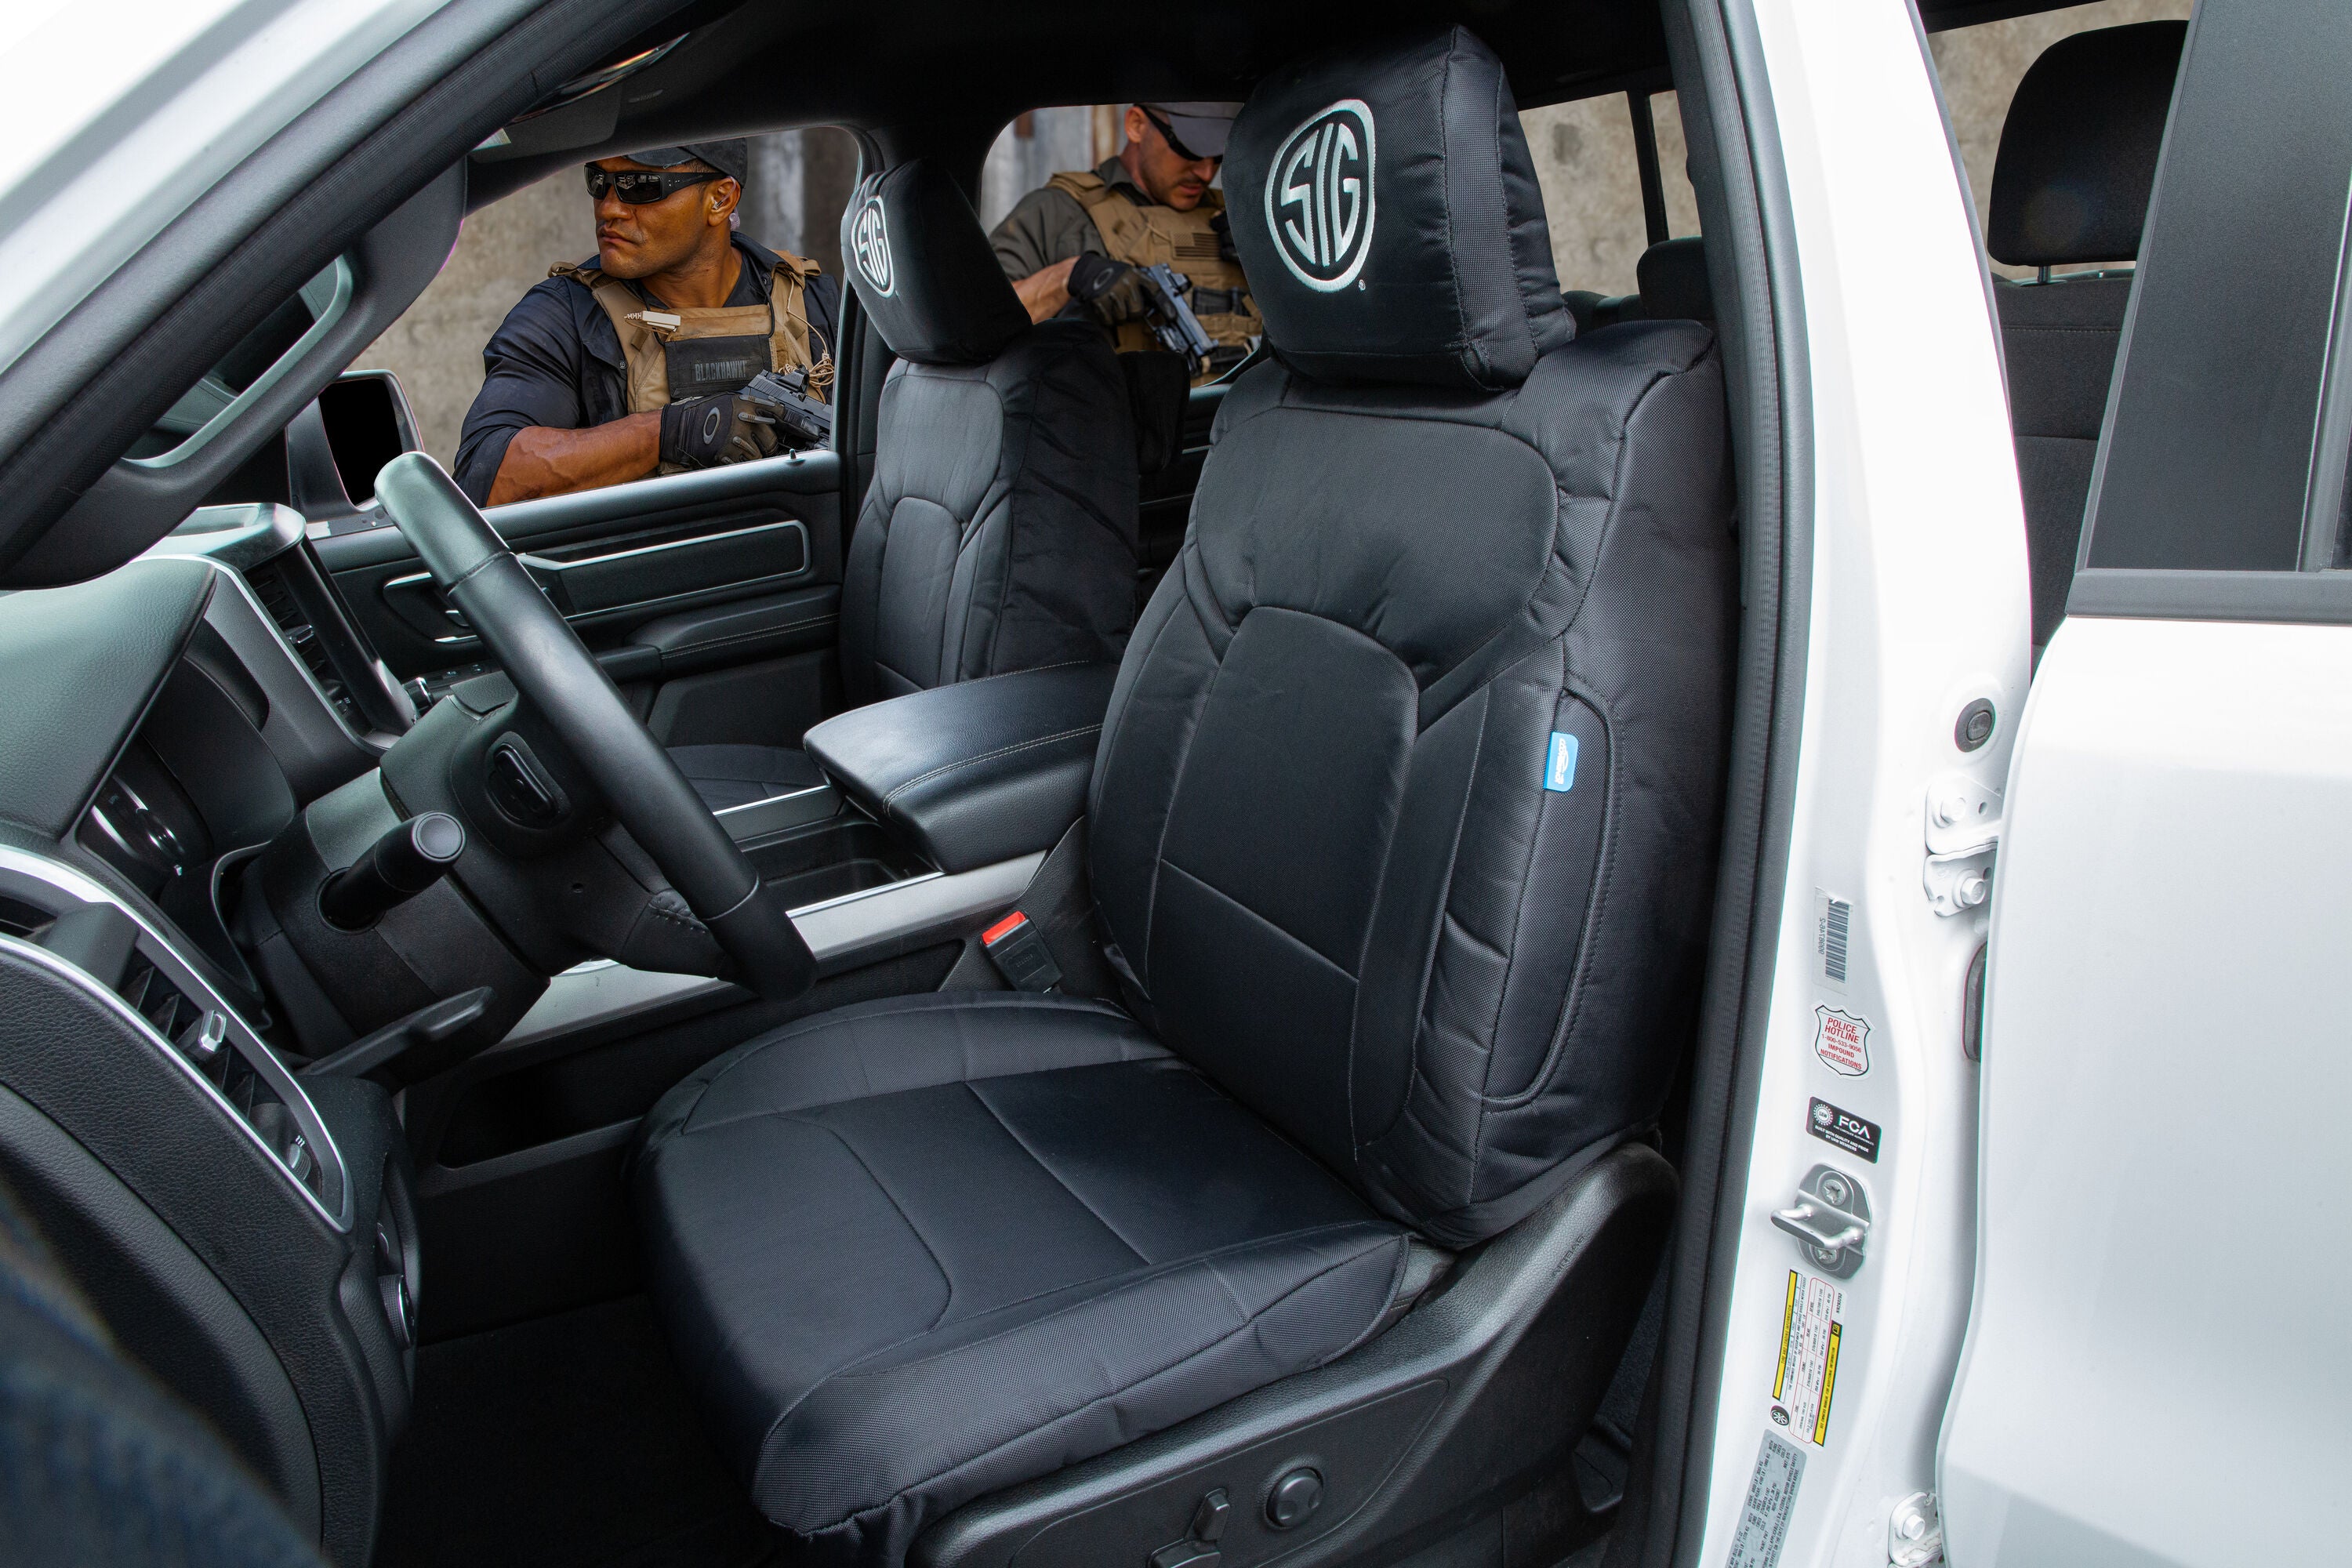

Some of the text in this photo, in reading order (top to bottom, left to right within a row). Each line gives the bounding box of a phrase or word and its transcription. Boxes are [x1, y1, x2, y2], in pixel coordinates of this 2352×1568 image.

[1279, 122, 1360, 267] SIG
[858, 208, 887, 287] SIG
[695, 360, 746, 381] BLACKHAWK!
[1825, 1025, 1860, 1044] HOTLINE
[1828, 1018, 1857, 1034] POLICE
[1822, 1034, 1861, 1053] 1-800-533-9056
[1828, 1044, 1854, 1058] IMPOUND
[1820, 1048, 1861, 1069] NOTIFICATIONS
[1838, 1115, 1871, 1139] FCA
[1834, 1133, 1849, 1144] QUALITY
[1857, 1144, 1868, 1152] PRIDE
[1838, 1140, 1857, 1152] MEMBERS
[1781, 1495, 1791, 1520] MANUFACTURE
[1769, 1523, 1778, 1543] APPLICABLE
